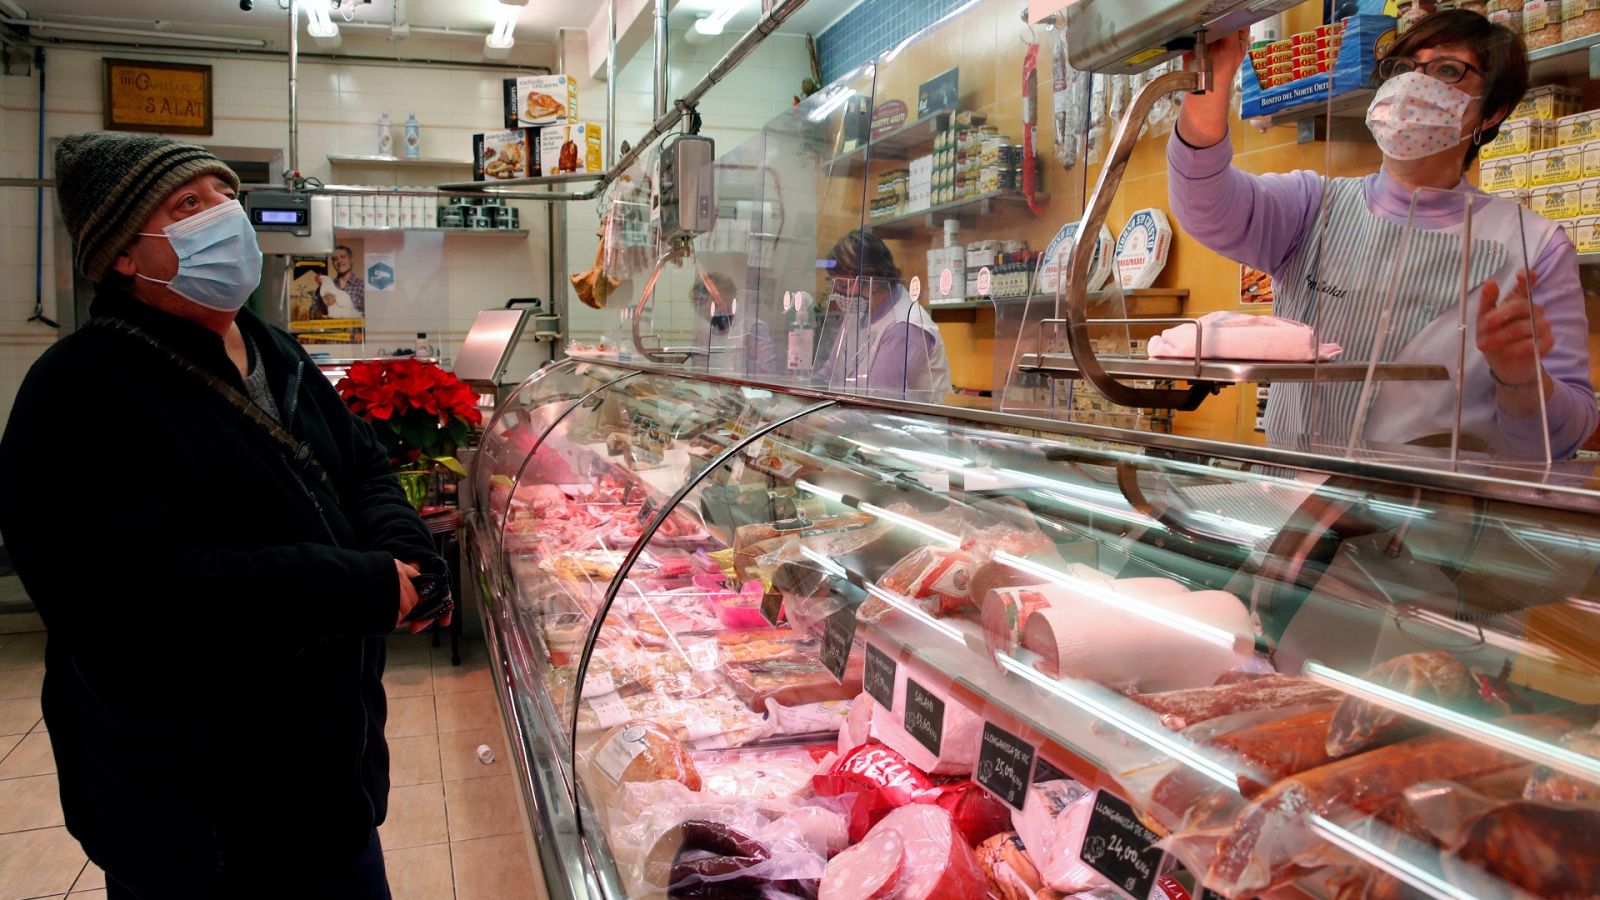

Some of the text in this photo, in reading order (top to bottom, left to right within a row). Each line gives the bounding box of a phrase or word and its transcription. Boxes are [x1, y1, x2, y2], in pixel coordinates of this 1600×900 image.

[1261, 82, 1330, 107] BONITO DEL NORTE ORTI
